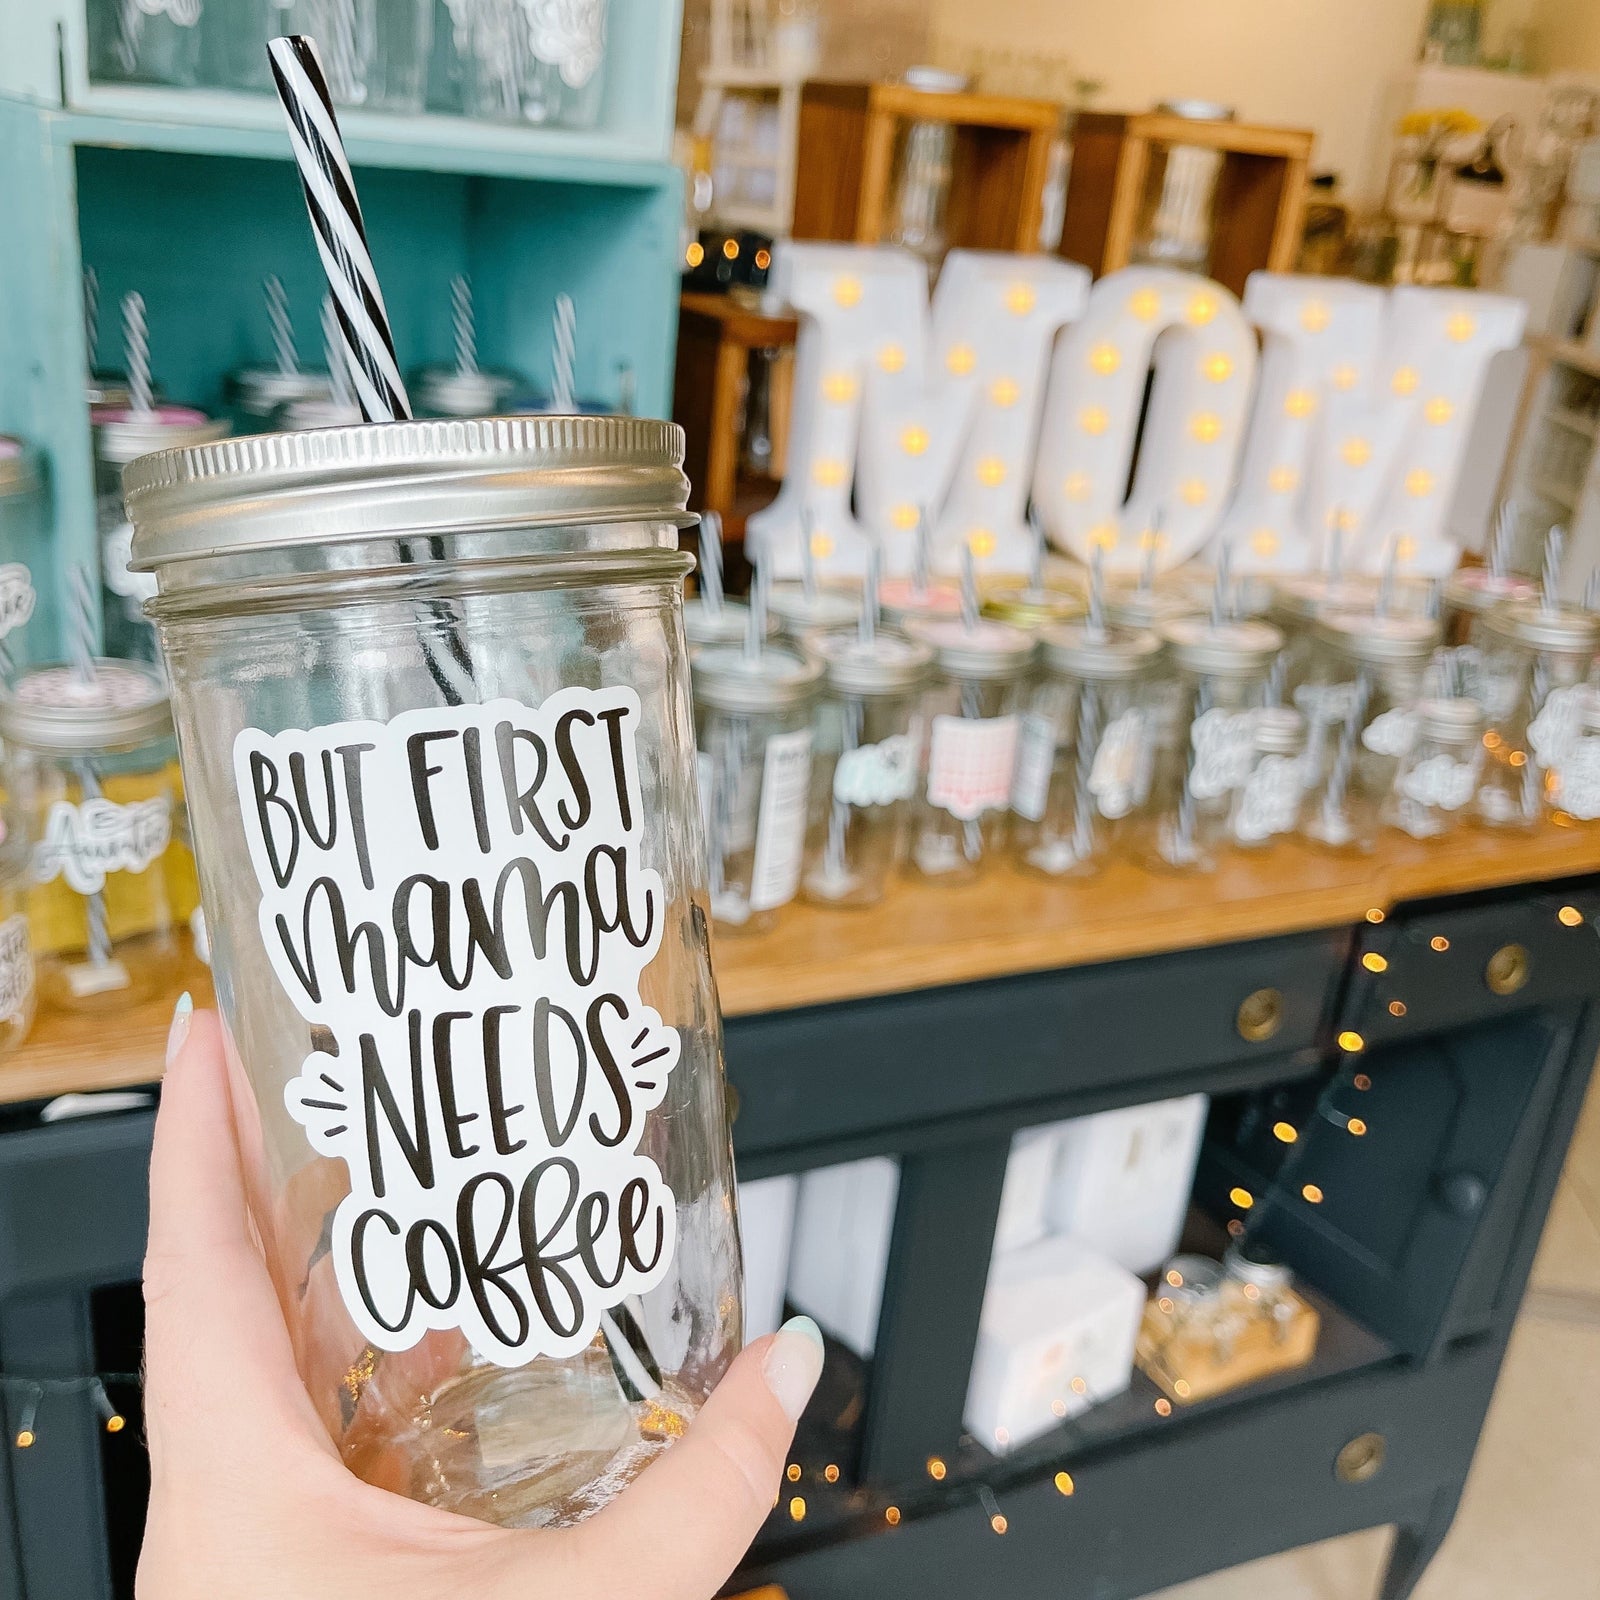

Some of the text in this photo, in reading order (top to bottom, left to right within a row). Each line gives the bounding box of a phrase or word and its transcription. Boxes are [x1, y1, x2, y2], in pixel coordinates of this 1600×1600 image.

[746, 240, 1527, 580] MOM
[249, 742, 376, 890] BUT
[406, 706, 630, 854] FIRST
[275, 843, 654, 1018] mama
[358, 992, 633, 1199] NEEDS
